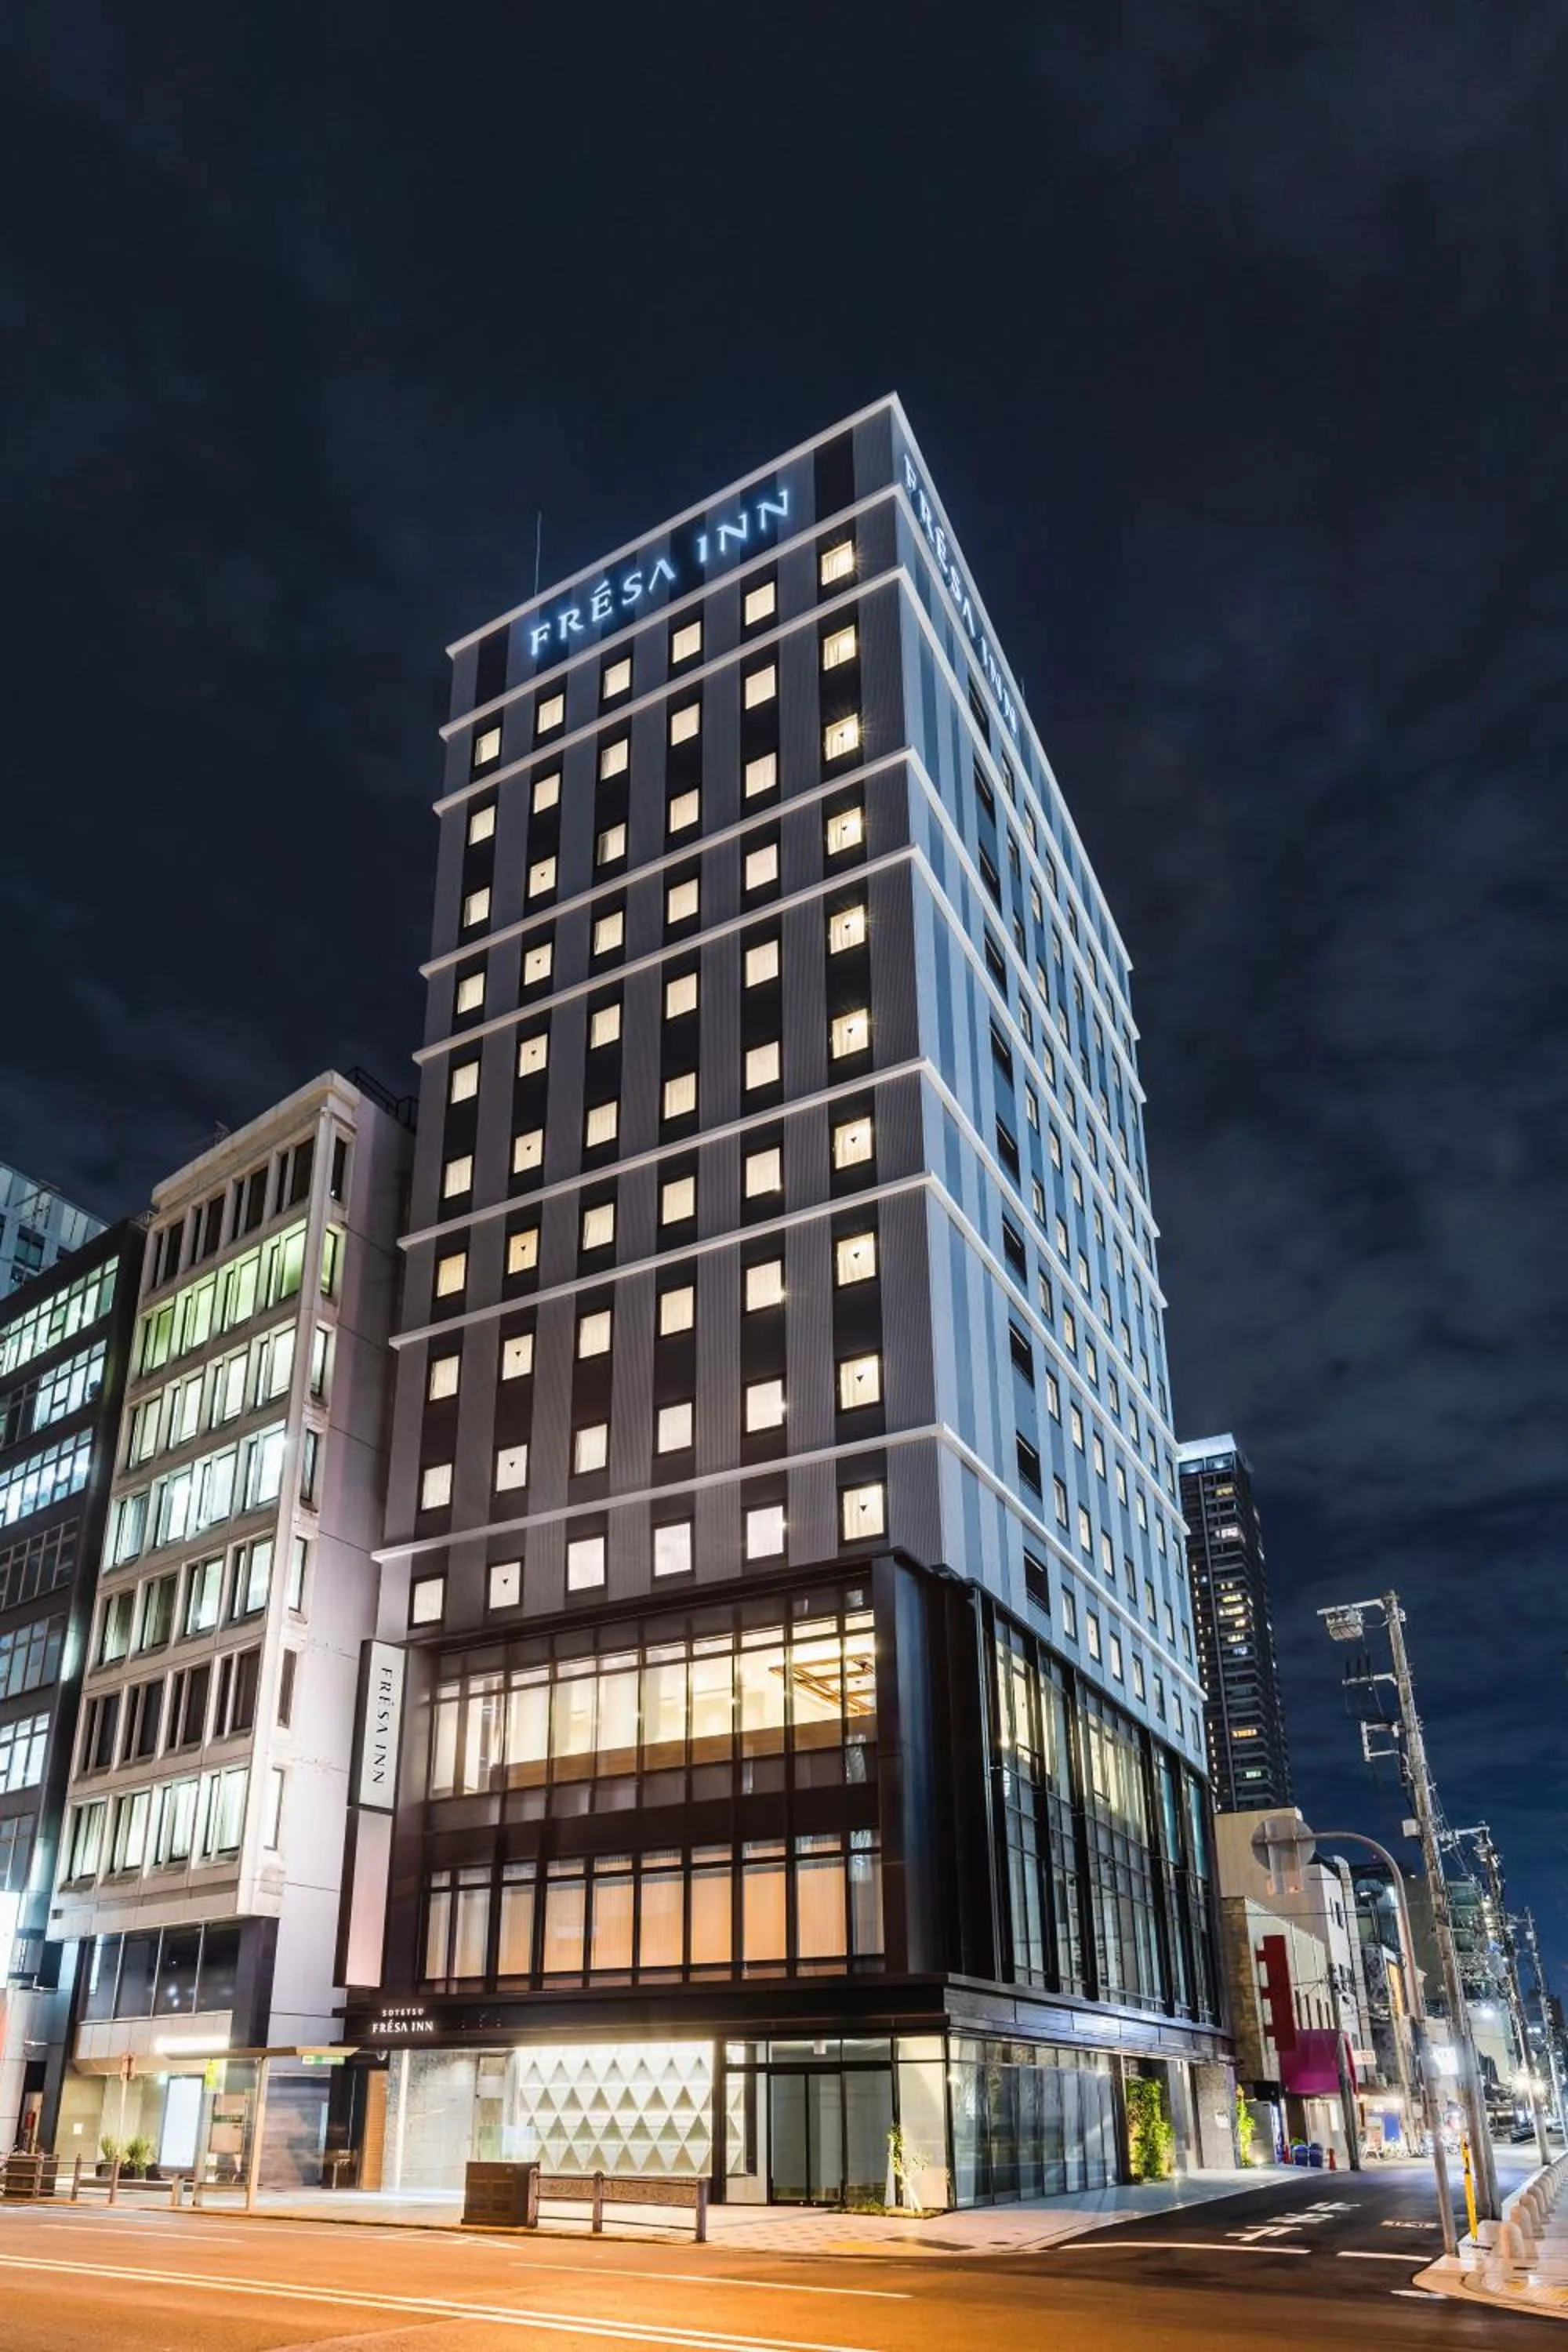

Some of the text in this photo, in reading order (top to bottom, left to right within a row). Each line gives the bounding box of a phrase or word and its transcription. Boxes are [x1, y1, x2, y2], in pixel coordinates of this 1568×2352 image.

[530, 489, 789, 655] FRÉSA INN
[372, 1668, 394, 1784] FRÉSA INN
[372, 2020, 434, 2033] FRÉSA INN
